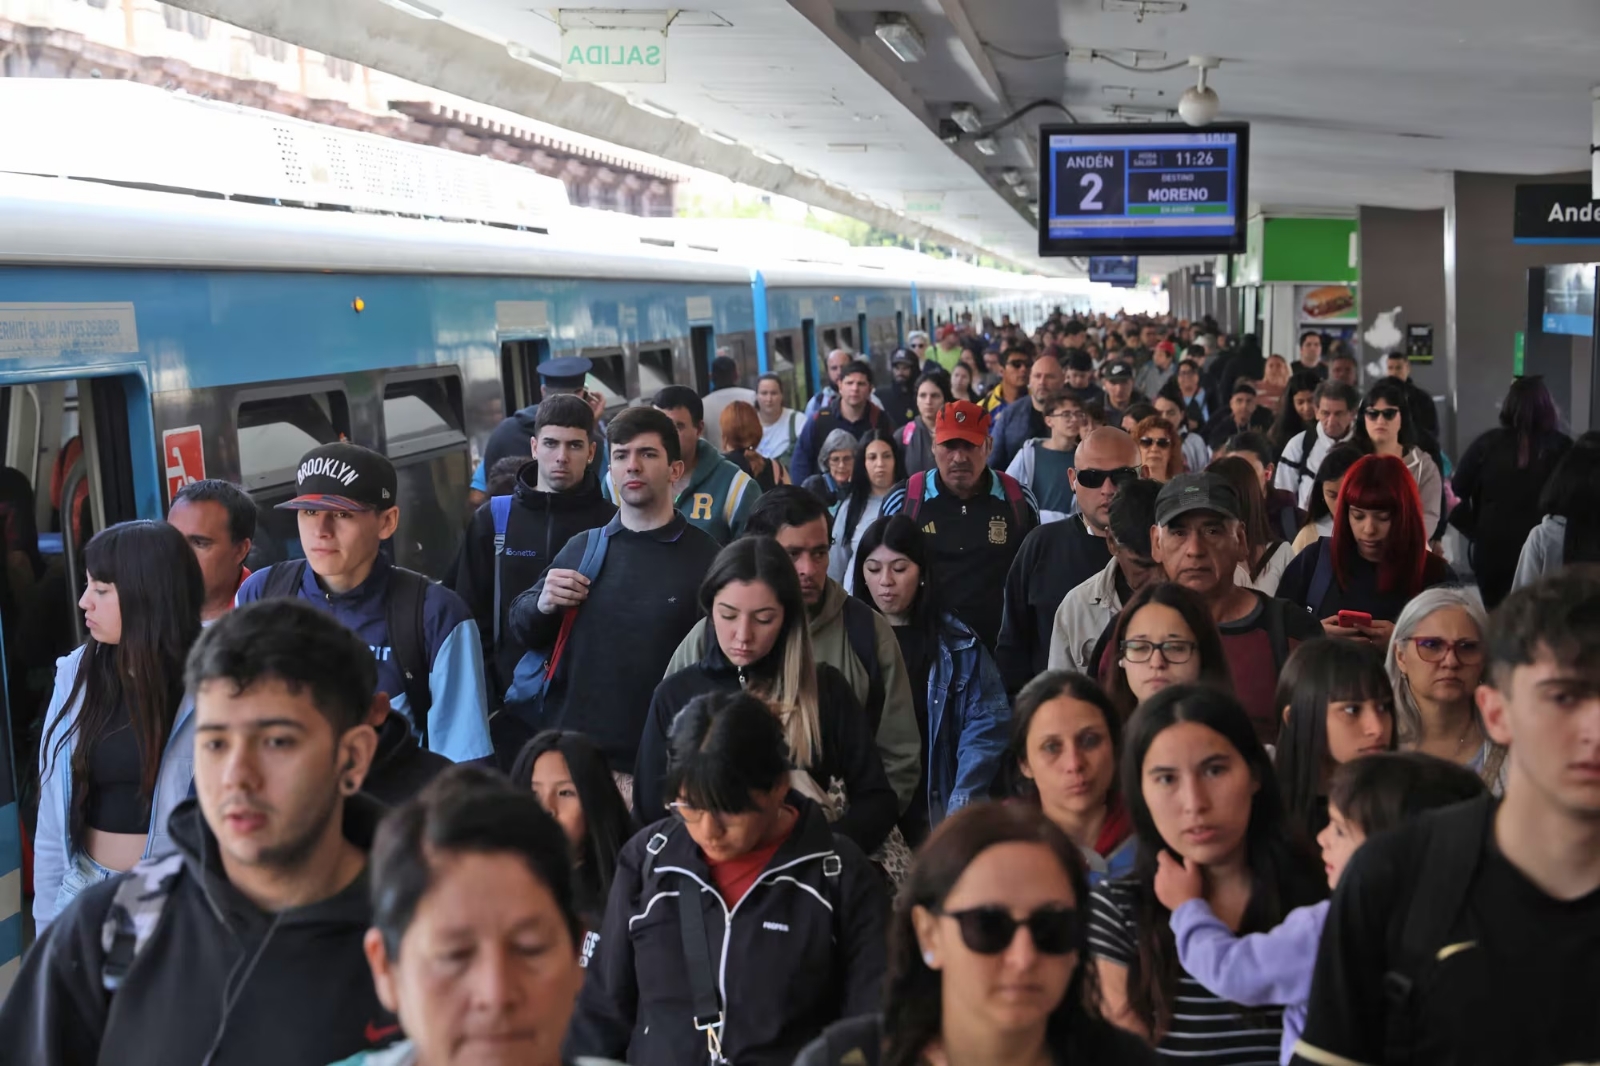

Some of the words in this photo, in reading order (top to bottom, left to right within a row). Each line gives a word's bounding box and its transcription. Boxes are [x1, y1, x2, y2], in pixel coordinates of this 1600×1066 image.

[1066, 153, 1114, 169] ANDÉN
[1176, 152, 1214, 166] 11:26
[1161, 173, 1194, 183] DESTINO
[1079, 172, 1103, 210] 2
[1148, 187, 1208, 202] MORENO
[297, 457, 359, 487] BROOKLYN
[690, 492, 714, 520] R
